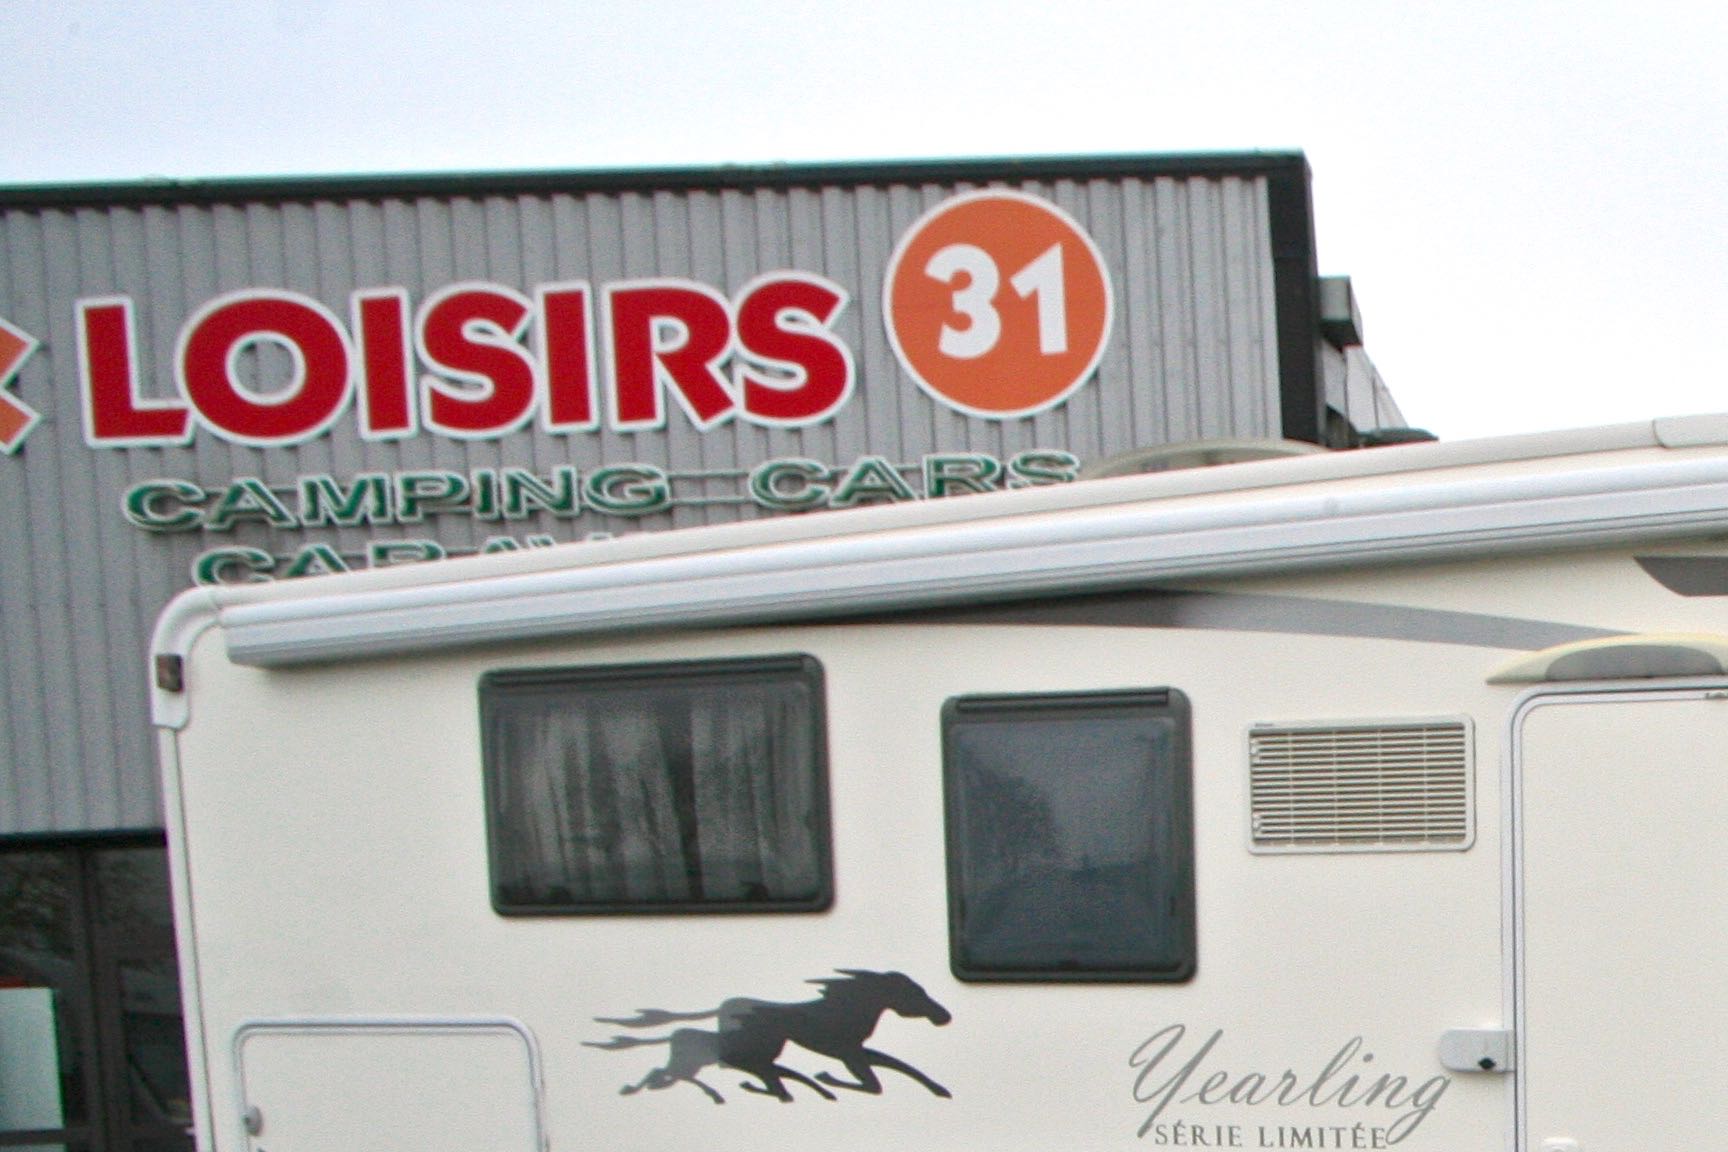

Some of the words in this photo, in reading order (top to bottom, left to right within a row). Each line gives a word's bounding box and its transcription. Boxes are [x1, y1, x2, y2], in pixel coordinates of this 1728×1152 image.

[78, 273, 852, 443] LOISIRS
[924, 241, 1069, 359] 31
[123, 463, 671, 531] CAMPING
[749, 449, 1081, 509] CARS
[1129, 1023, 1451, 1146] Yearling
[1154, 1119, 1243, 1147] SÉRIE
[1257, 1121, 1388, 1150] LIMITÉE
